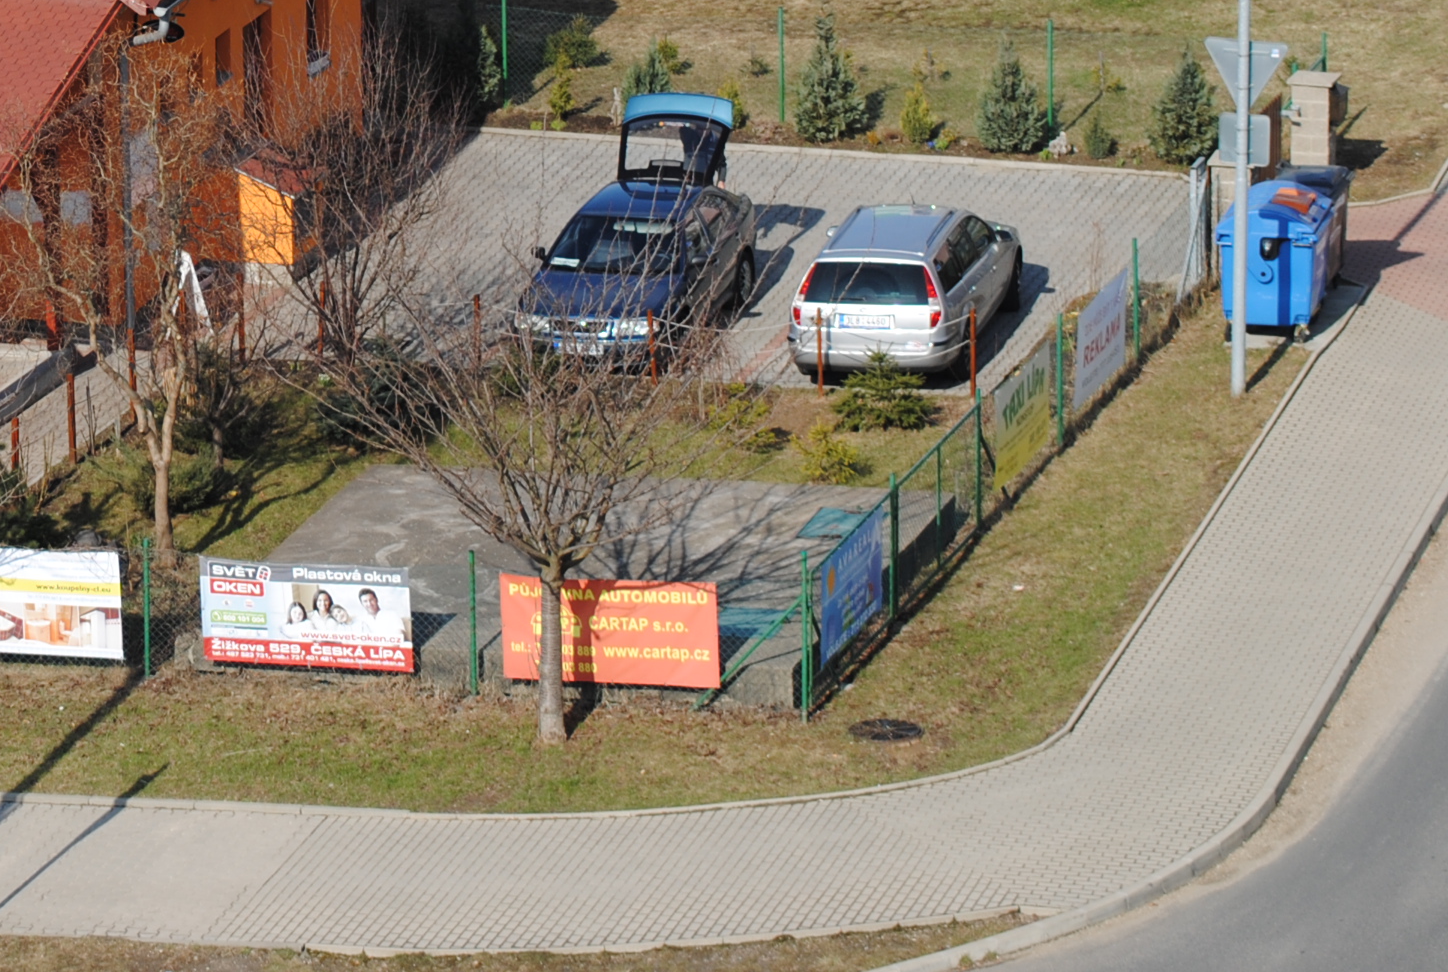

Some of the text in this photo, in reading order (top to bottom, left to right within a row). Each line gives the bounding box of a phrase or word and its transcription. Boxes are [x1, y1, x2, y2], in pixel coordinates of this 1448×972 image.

[212, 564, 256, 578] SVĚT
[292, 567, 401, 583] Plastová okna
[213, 581, 260, 594] OKEN
[508, 582, 708, 605] PŮJVNA AUTOMOBILŮ
[588, 615, 688, 633] CARTAP s.r.o.
[300, 632, 401, 644] www.svet-oken.cz
[211, 637, 406, 660] Žižkova 529, ČESKÁ LÍPA
[511, 641, 531, 653] tel.:
[603, 645, 710, 662] www.cartap.cz
